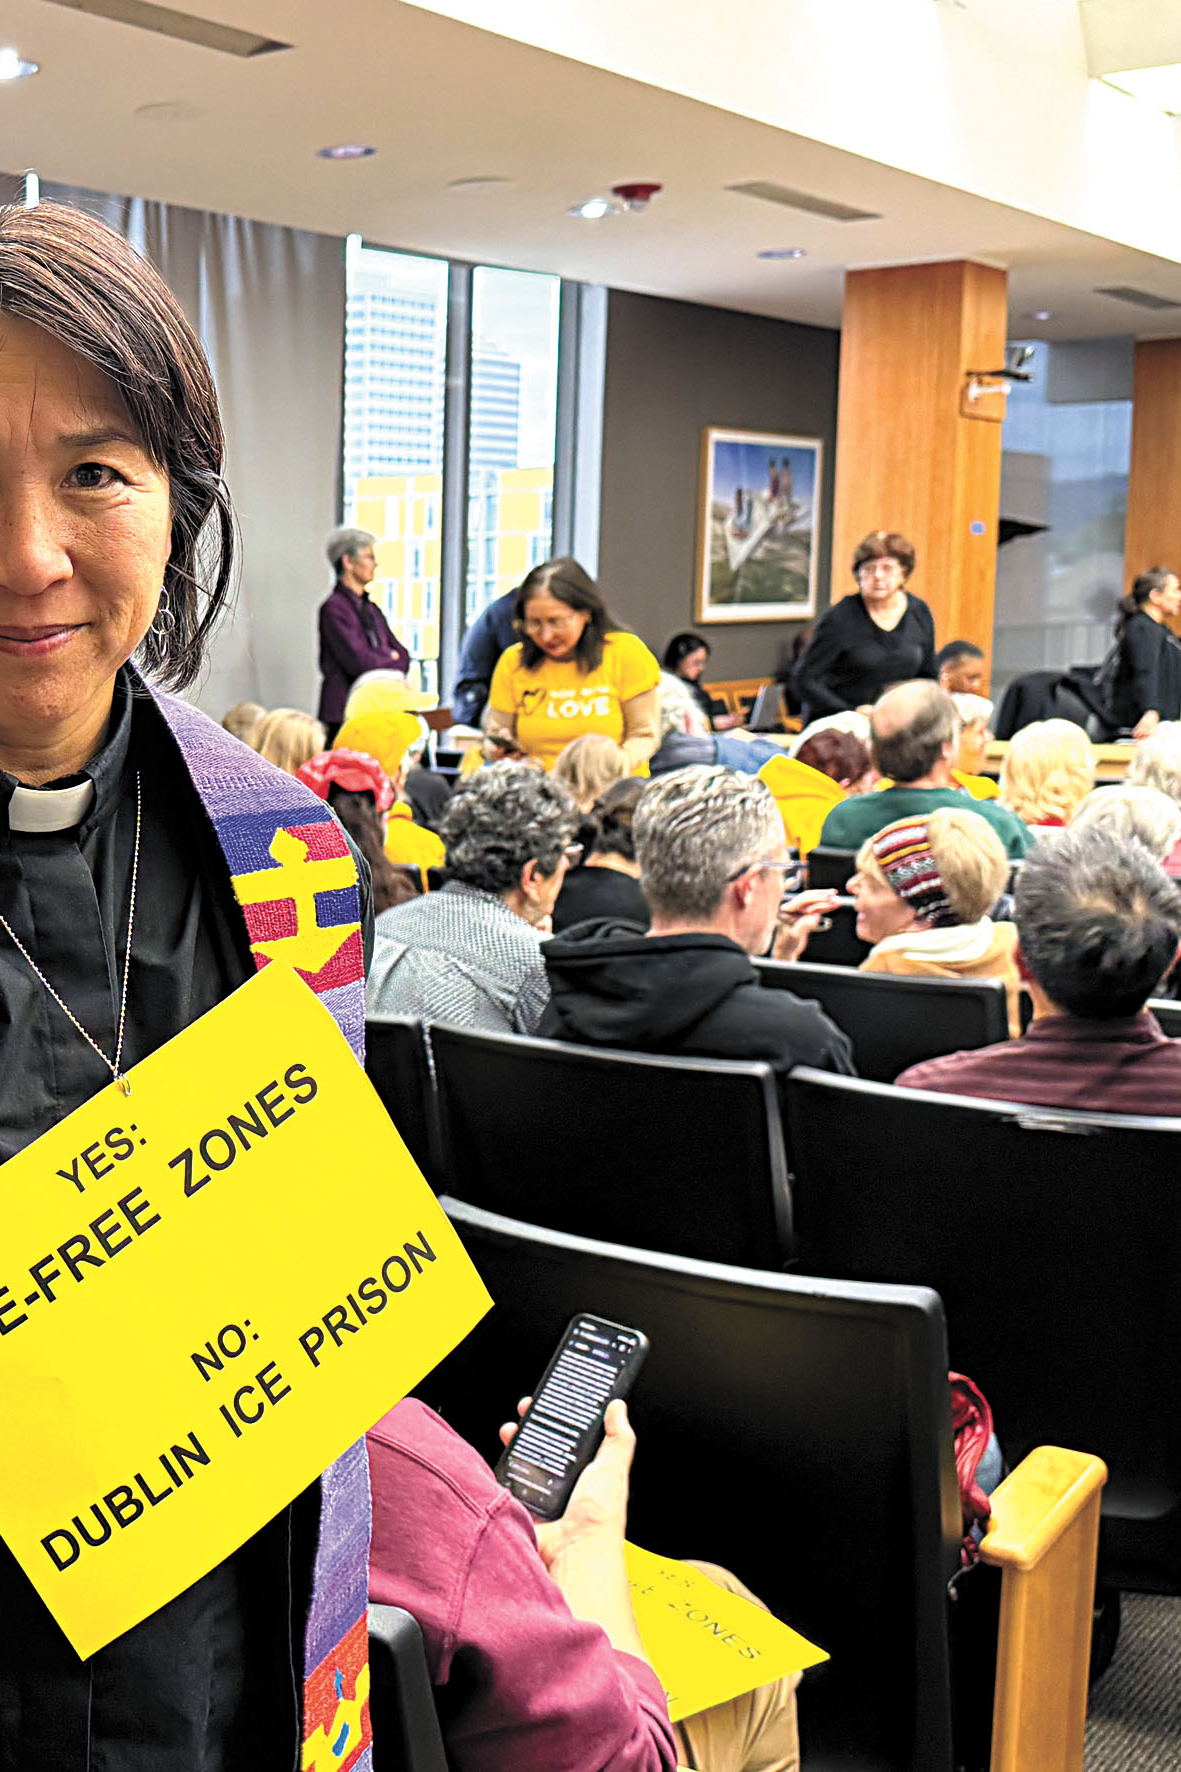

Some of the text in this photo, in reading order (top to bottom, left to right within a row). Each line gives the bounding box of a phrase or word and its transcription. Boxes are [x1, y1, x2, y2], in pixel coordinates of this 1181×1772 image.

[547, 696, 610, 718] LOVE
[56, 1122, 147, 1193] YES:
[167, 1063, 318, 1198] ZONES
[190, 1319, 260, 1382] NO:
[41, 1230, 437, 1571] DUBLIN ICE PRISON
